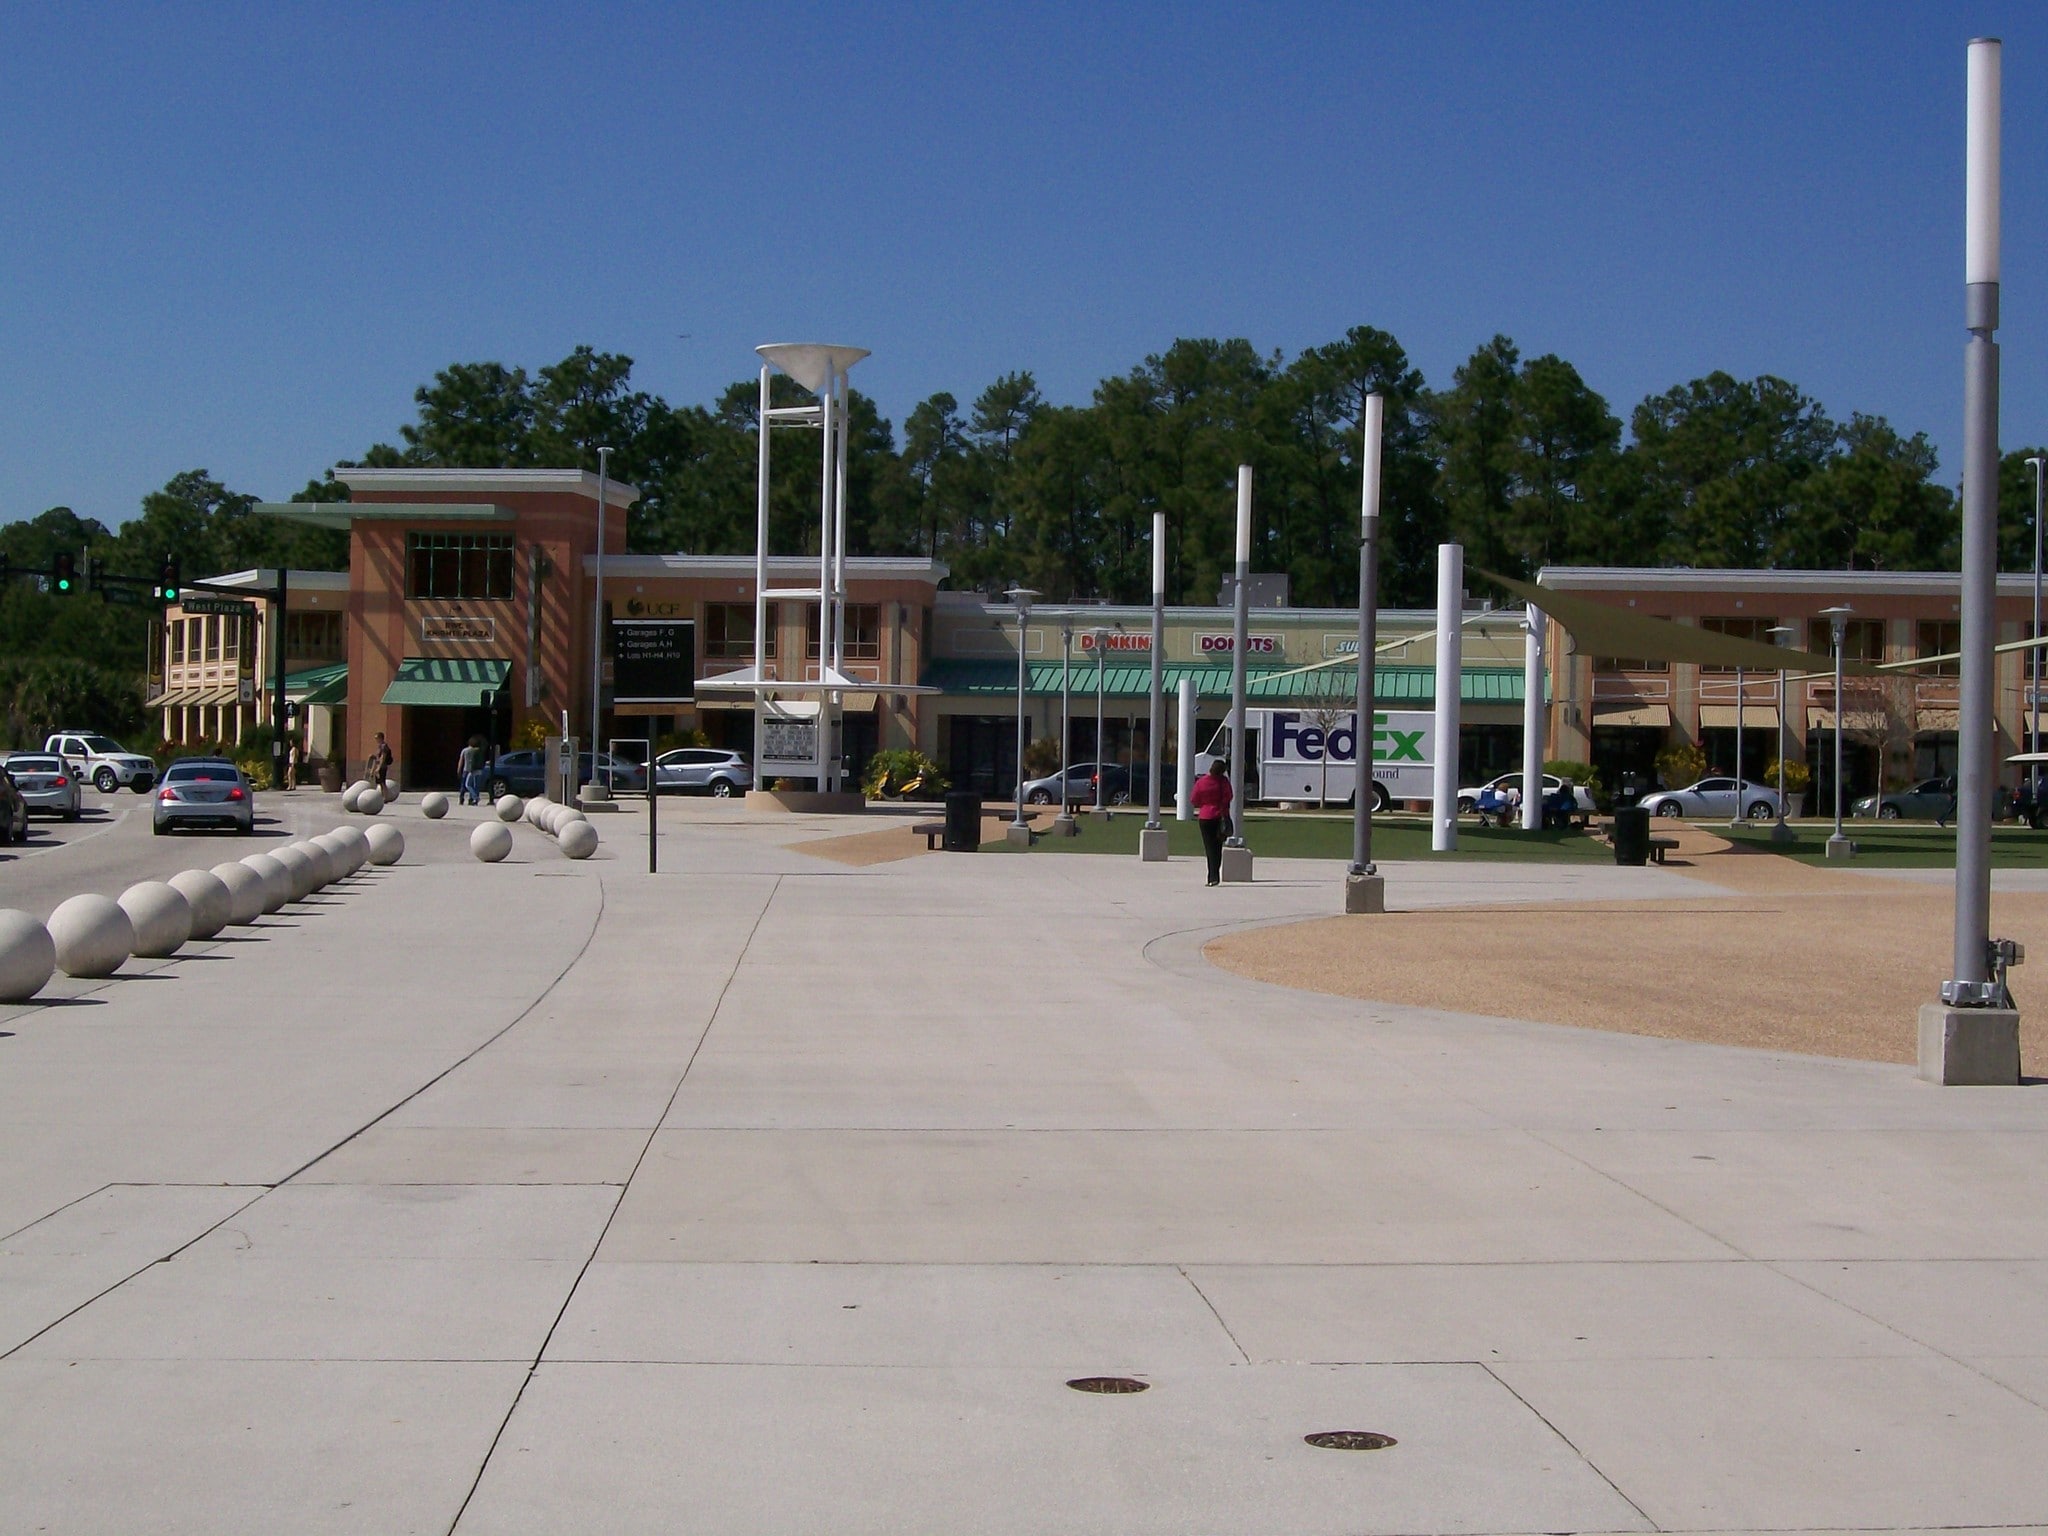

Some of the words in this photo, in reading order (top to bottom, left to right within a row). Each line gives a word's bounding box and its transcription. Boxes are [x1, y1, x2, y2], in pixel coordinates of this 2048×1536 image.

[187, 602, 211, 611] West
[214, 603, 242, 613] Plaza
[647, 603, 680, 616] UCF
[626, 628, 658, 638] Garages
[626, 640, 658, 650] Garages
